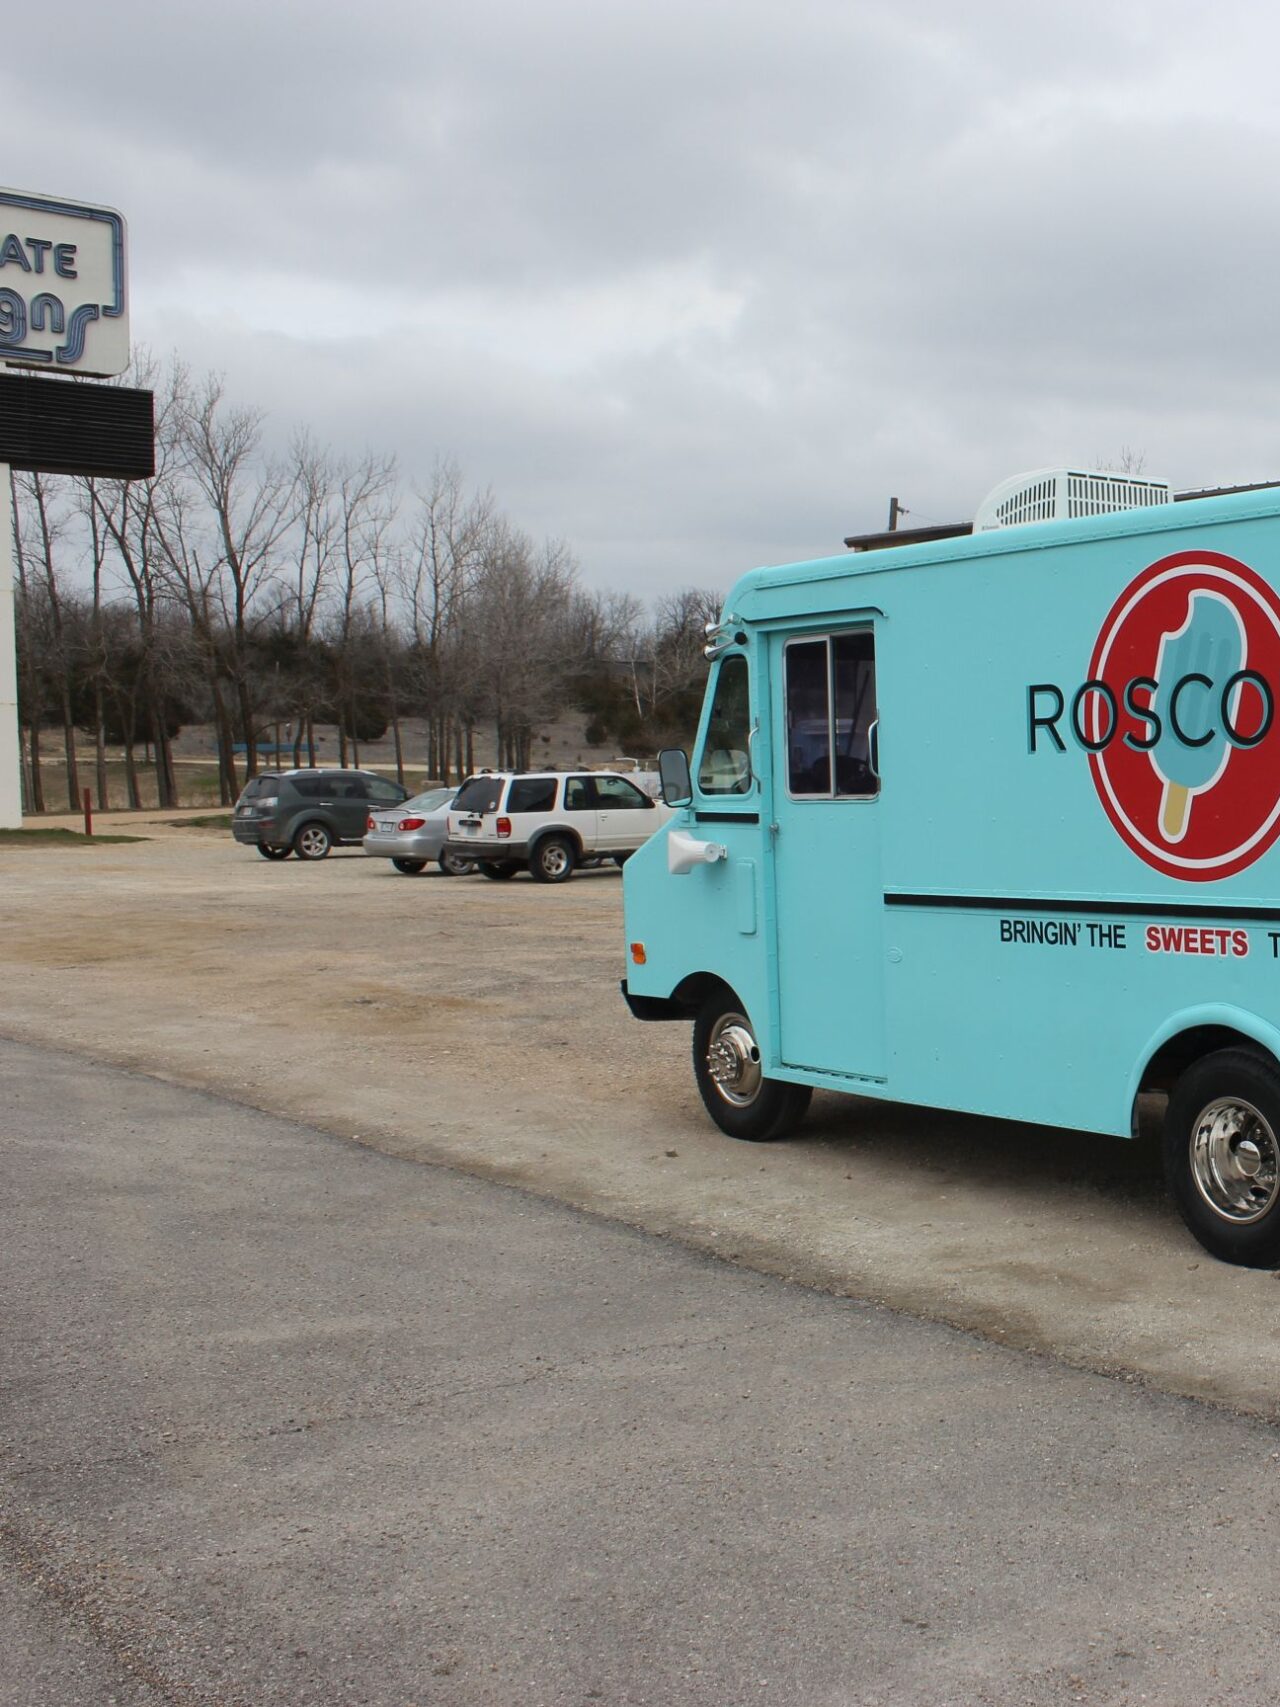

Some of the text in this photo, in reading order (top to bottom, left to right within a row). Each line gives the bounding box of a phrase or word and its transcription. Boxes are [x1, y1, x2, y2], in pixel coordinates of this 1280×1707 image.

[1000, 919, 1081, 946] BRINGIN'
[1086, 923, 1126, 949] THE
[1145, 924, 1249, 958] SWEETS
